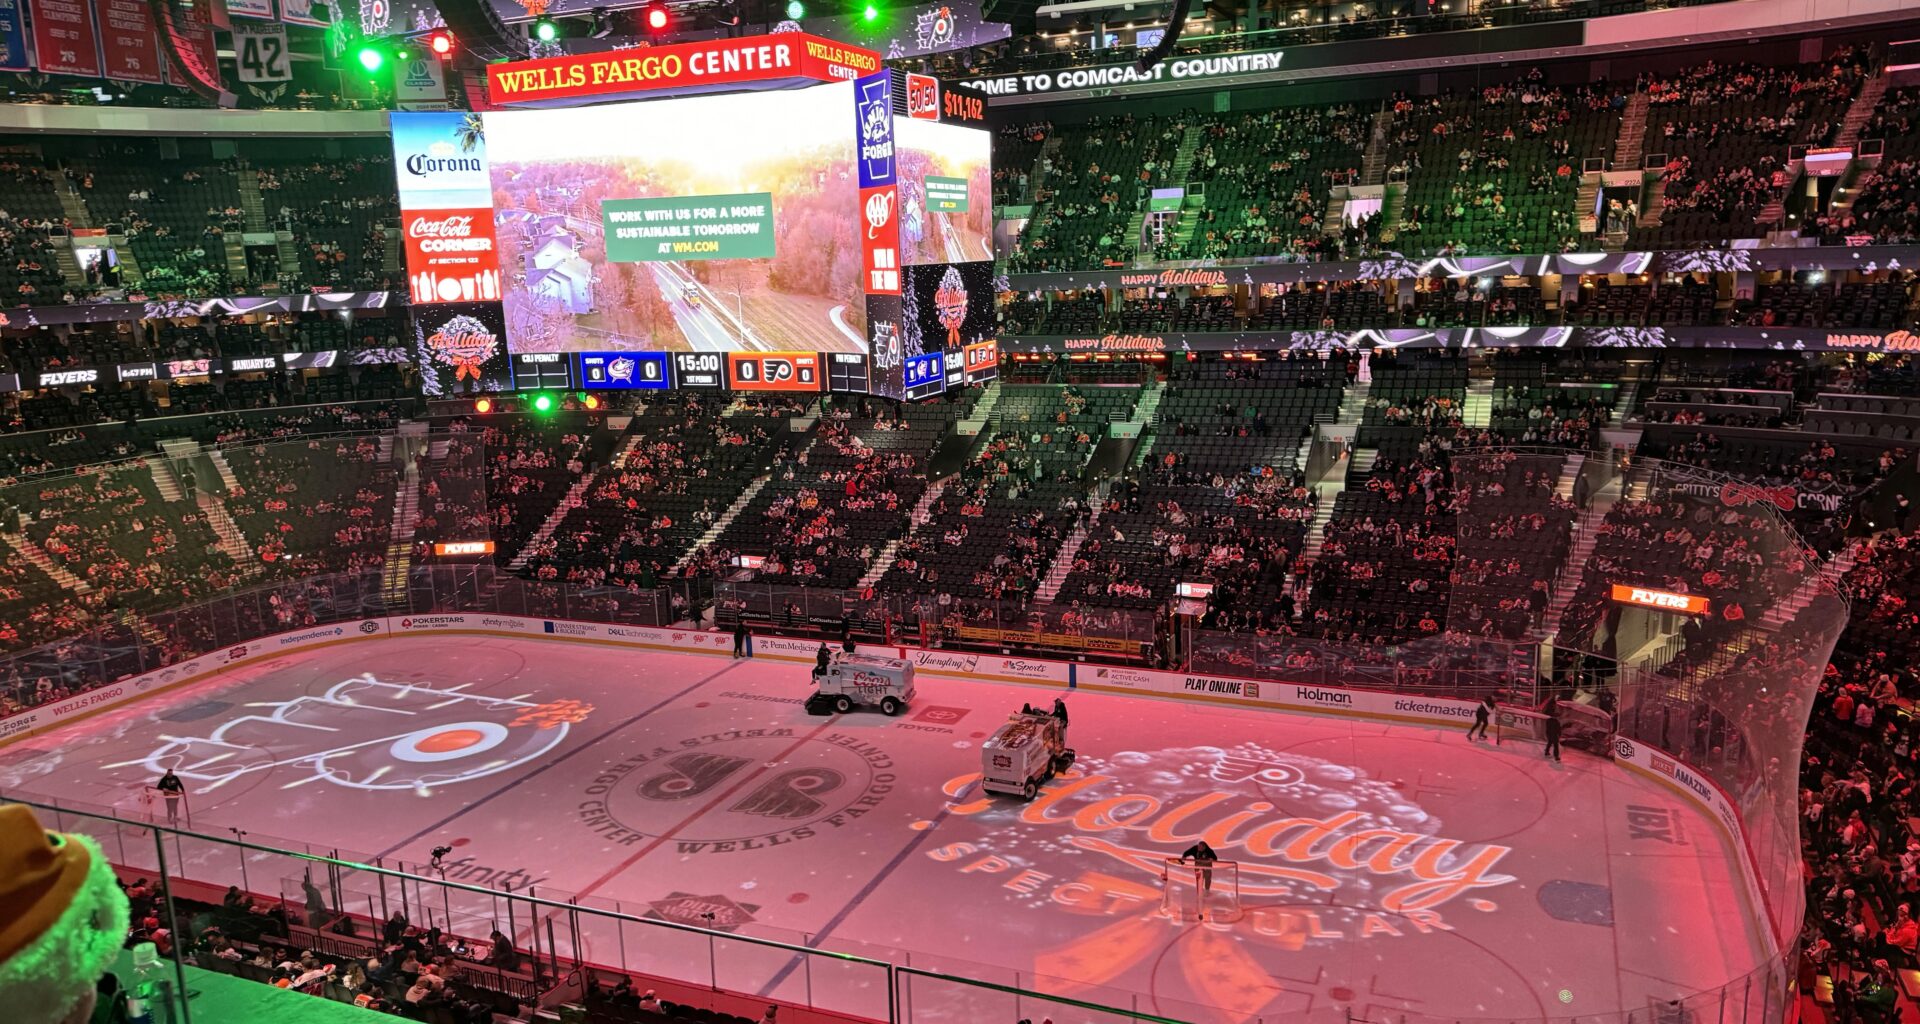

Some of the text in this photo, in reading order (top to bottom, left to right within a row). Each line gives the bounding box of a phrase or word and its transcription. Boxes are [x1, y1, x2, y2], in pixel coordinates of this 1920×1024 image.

[242, 36, 285, 78] 42
[806, 42, 876, 71] WELLS FARGO
[498, 43, 791, 94] WELLS FARGO CENTER
[828, 64, 859, 80] CENTER
[1025, 75, 1051, 91] TO
[1171, 52, 1284, 77] COUNTRY
[944, 89, 984, 121] $11,162
[862, 141, 893, 160] FORGE
[406, 153, 481, 178] Corona
[608, 205, 765, 223] WORK WITH US FOR A MORE
[409, 216, 473, 238] Coca-Cola
[615, 222, 760, 239] SUSTAINABLE TOMORROW
[420, 237, 492, 254] CORNER
[658, 241, 719, 254] AT WM.COM
[1121, 267, 1227, 286] HAPPY Holidays
[427, 331, 498, 354] Holiday
[1065, 333, 1166, 350] HAPPY Holidays
[1826, 334, 1881, 348] HAPPY
[232, 358, 275, 371] JANUARY 25
[677, 354, 718, 371] 15:00
[945, 352, 963, 370] 15:00
[40, 370, 97, 386] FLYERS
[592, 368, 600, 380] 0
[645, 362, 656, 379] 0
[742, 362, 753, 379] 0
[802, 369, 809, 381] 0
[1797, 492, 1843, 512] CORNE
[1631, 589, 1690, 609] FLYERS
[412, 616, 465, 624] POKERSTARS
[280, 628, 334, 645] Independence
[608, 627, 625, 637] DELL
[770, 640, 818, 652] Penn Medicine
[915, 651, 963, 669] Yuengling
[1014, 660, 1046, 672] Sports
[853, 671, 891, 686] Coors
[1111, 674, 1132, 682] ACTIVE
[1185, 678, 1208, 691] PLAY
[1208, 680, 1242, 694] ONLINE
[857, 686, 888, 695] LIGHT
[1297, 687, 1352, 704] Holman
[52, 688, 123, 717] WELLS FARGO
[1394, 699, 1477, 718] ticketmaster
[4, 715, 37, 731] FORGE
[897, 723, 953, 734] TOYOTA
[578, 728, 794, 846] WELLS FARGO CENTER
[676, 732, 896, 854] WELLS FARGO CENTER
[1675, 768, 1711, 802] AMAZING
[1626, 805, 1674, 844] IBX
[942, 770, 1516, 912] Holiday
[926, 841, 1456, 940] SPECTACULAR
